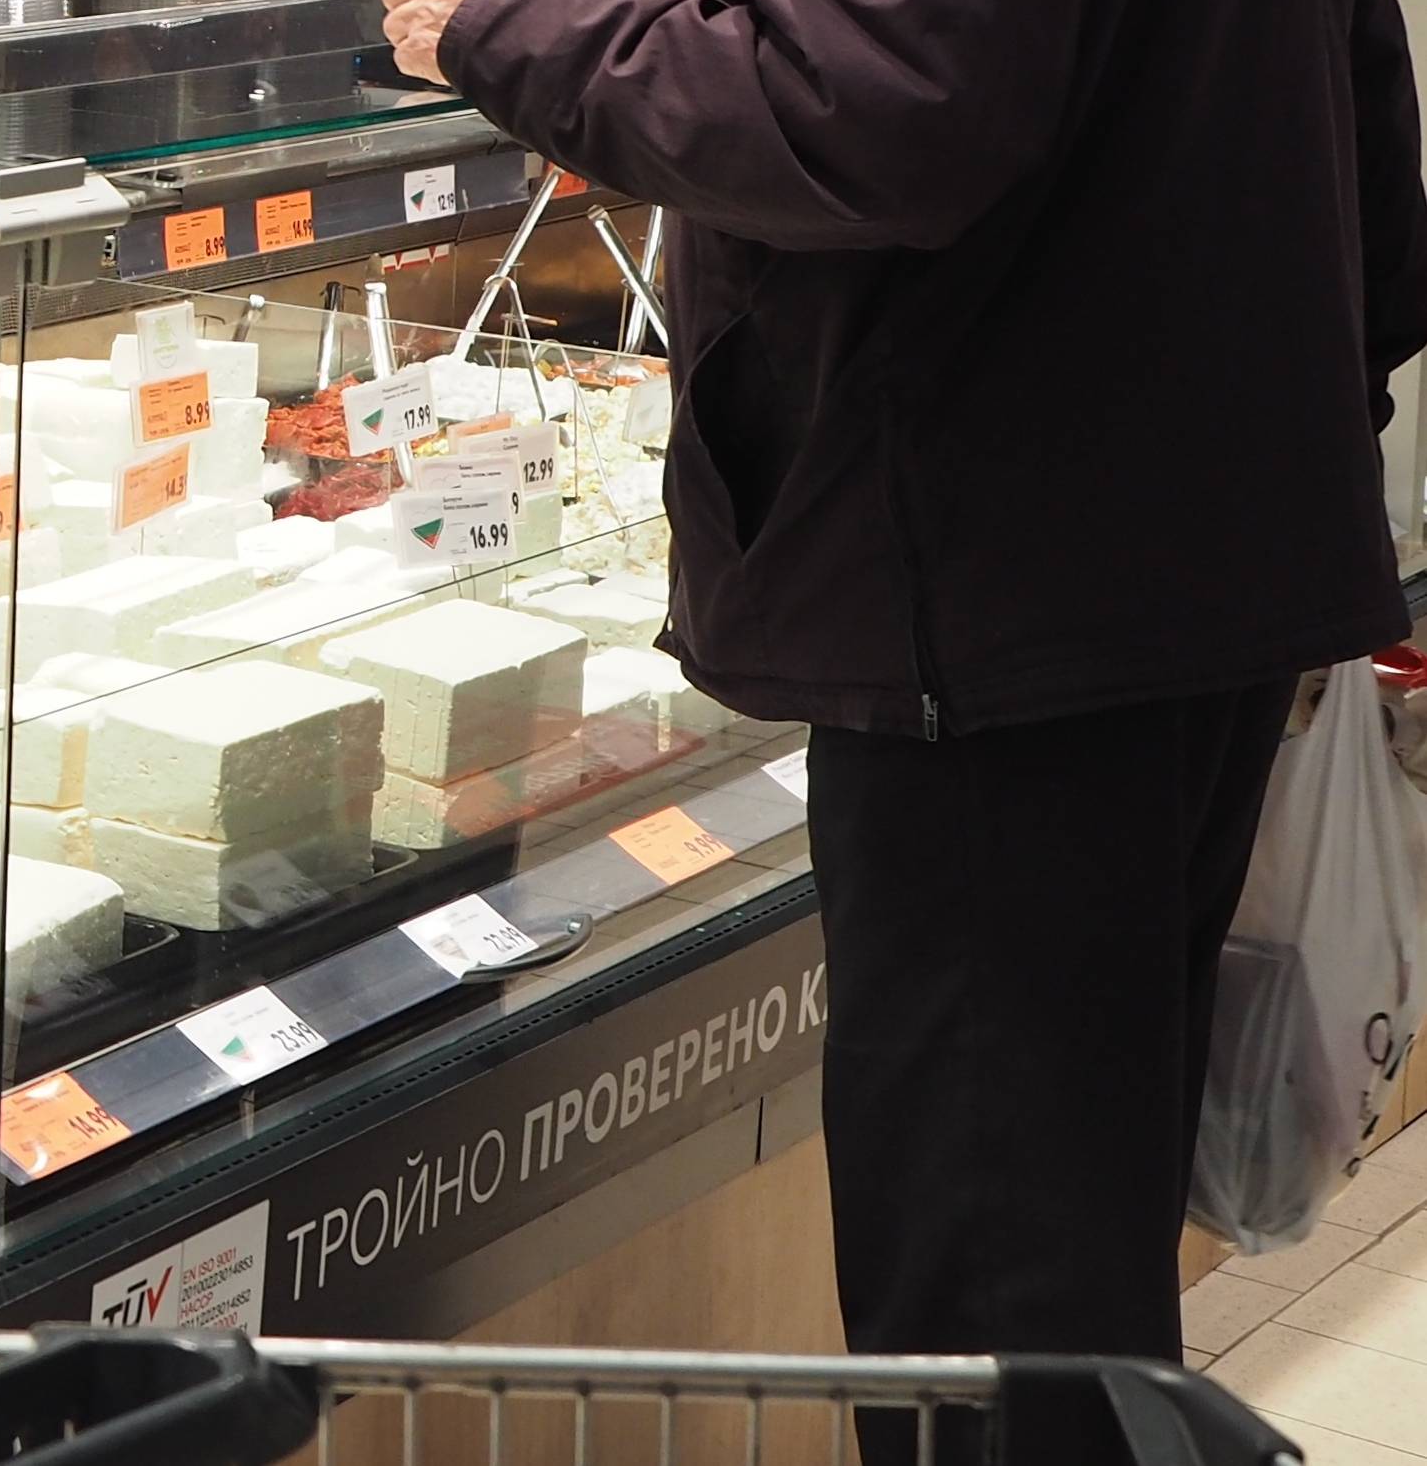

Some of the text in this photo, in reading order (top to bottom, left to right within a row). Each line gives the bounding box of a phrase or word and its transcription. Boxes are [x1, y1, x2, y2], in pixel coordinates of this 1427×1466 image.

[293, 219, 312, 239] 14.99
[205, 236, 225, 257] 8.99
[185, 401, 210, 425] 8.99
[404, 404, 431, 430] 17.99
[524, 457, 554, 484] 12.99
[165, 472, 188, 502] 14.3
[470, 523, 508, 548] 16.99
[683, 833, 724, 859] 9.99
[483, 926, 527, 953] 22.99
[271, 1021, 319, 1053] 23.99
[68, 1105, 120, 1141] 14.99
[287, 961, 827, 1300] ТРОЙНО ПРОВЕРЕНО К
[102, 1265, 173, 1325] TÜV
